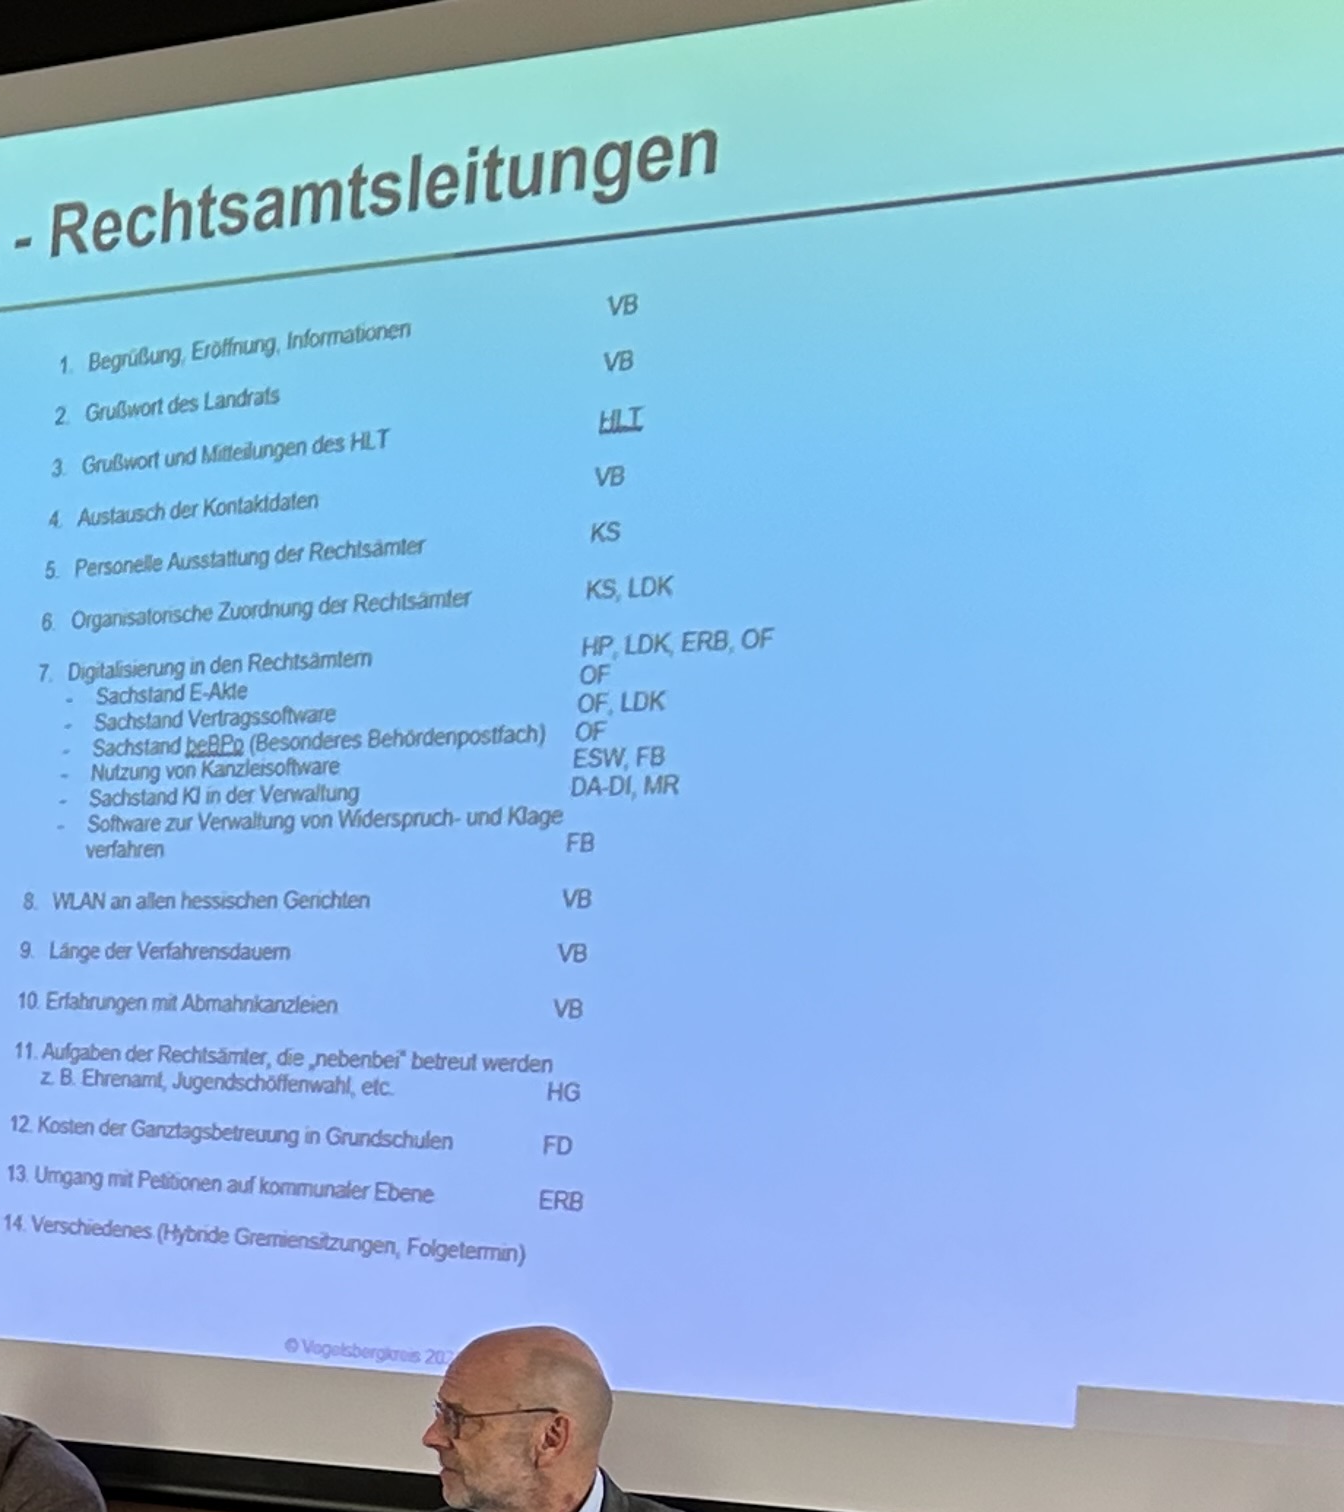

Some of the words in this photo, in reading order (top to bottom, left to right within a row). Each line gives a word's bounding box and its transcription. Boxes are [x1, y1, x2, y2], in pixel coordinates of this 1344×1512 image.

[49, 125, 718, 258] Rechtsamtsleitungen
[606, 293, 638, 316] VB
[286, 322, 411, 350] Informationen
[603, 349, 634, 372] VB
[85, 397, 164, 422] Grußwort
[168, 393, 199, 415] des
[204, 386, 281, 411] Landrats
[598, 406, 645, 436] HLT
[82, 450, 160, 475] Grußwort
[164, 446, 197, 468] und
[201, 440, 307, 464] Mitteilungen
[312, 434, 345, 455] des
[350, 428, 391, 452] HLT
[594, 465, 625, 487] VB
[77, 502, 166, 527] Austausch
[169, 500, 199, 520] der
[203, 491, 319, 517] Kontaktdaten
[590, 521, 621, 544] KS
[75, 554, 163, 578] Personelle
[167, 549, 270, 572] Ausstattung
[274, 544, 305, 564] der
[309, 538, 427, 562] Rechtsämter
[628, 575, 674, 599] LDK
[71, 604, 213, 633] Organisatorische
[217, 599, 314, 622] Zuordnung
[318, 596, 348, 615] der
[353, 589, 472, 613] Rechtsämter
[741, 627, 775, 650] OF
[68, 659, 185, 685] Digitalisierung
[190, 658, 205, 675] in
[210, 655, 243, 674] den
[248, 651, 373, 672] Rechtsämtern
[579, 664, 611, 685] OF
[96, 683, 186, 706] Sachstand
[190, 682, 248, 702] E-Akte
[620, 690, 668, 713] LDK
[93, 709, 184, 732] Sachstand
[188, 705, 337, 731] Vertragssoftware
[93, 736, 182, 758] Sachstand
[250, 731, 362, 757] (Besonderes
[368, 724, 546, 750] Behördenpostfach)
[575, 720, 608, 742] OF
[636, 745, 665, 768] FB
[91, 763, 161, 784] Nutzung
[166, 765, 196, 779] von
[201, 757, 341, 778] Kanzleisoftware
[89, 787, 178, 808] Sachstand
[182, 786, 200, 805] KI
[205, 786, 221, 805] in
[226, 785, 255, 804] der
[260, 783, 360, 806] Verwaltung
[644, 774, 680, 795] MR
[87, 814, 162, 833] Software
[165, 816, 193, 832] zur
[198, 811, 295, 835] Verwaltung
[301, 814, 333, 829] von
[466, 807, 502, 827] und
[508, 806, 564, 831] Klage
[85, 840, 165, 859] verfahren
[566, 832, 595, 853] FB
[52, 892, 106, 911] WLAN
[110, 896, 131, 910] an
[136, 892, 176, 910] allen
[181, 890, 278, 910] hessischen
[283, 890, 370, 910] Gerichten
[562, 888, 592, 909] VB
[49, 940, 101, 964] Länge
[105, 941, 133, 960] der
[137, 941, 291, 961] Verfahrensdauern
[557, 943, 587, 963] VB
[46, 991, 147, 1016] Erfahrungen
[152, 993, 178, 1012] mit
[180, 993, 338, 1015] Abmahnkanzleien
[553, 998, 583, 1019] VB
[41, 1042, 121, 1065] Aufgaben
[125, 1044, 154, 1063] der
[276, 1048, 304, 1067] die
[411, 1051, 477, 1071] betreut
[482, 1054, 553, 1073] werden
[547, 1081, 580, 1102] HG
[38, 1116, 95, 1136] Kosten
[98, 1118, 127, 1137] der
[131, 1119, 300, 1149] Ganztagsbetreuung
[304, 1126, 321, 1145] in
[326, 1126, 453, 1150] Grundschulen
[543, 1135, 573, 1156] FD
[34, 1165, 104, 1191] Umgang
[108, 1169, 134, 1188] mit
[138, 1170, 222, 1192] Petitionen
[226, 1175, 257, 1194] auf
[259, 1176, 371, 1200] kommunaler
[374, 1181, 435, 1204] Ebene
[539, 1189, 584, 1212] ERB
[31, 1214, 154, 1239] Verschiedenes
[157, 1223, 229, 1246] (Hybride
[407, 1237, 526, 1267] Folgetermin)
[302, 1339, 421, 1364] Vogelsbergkreis
